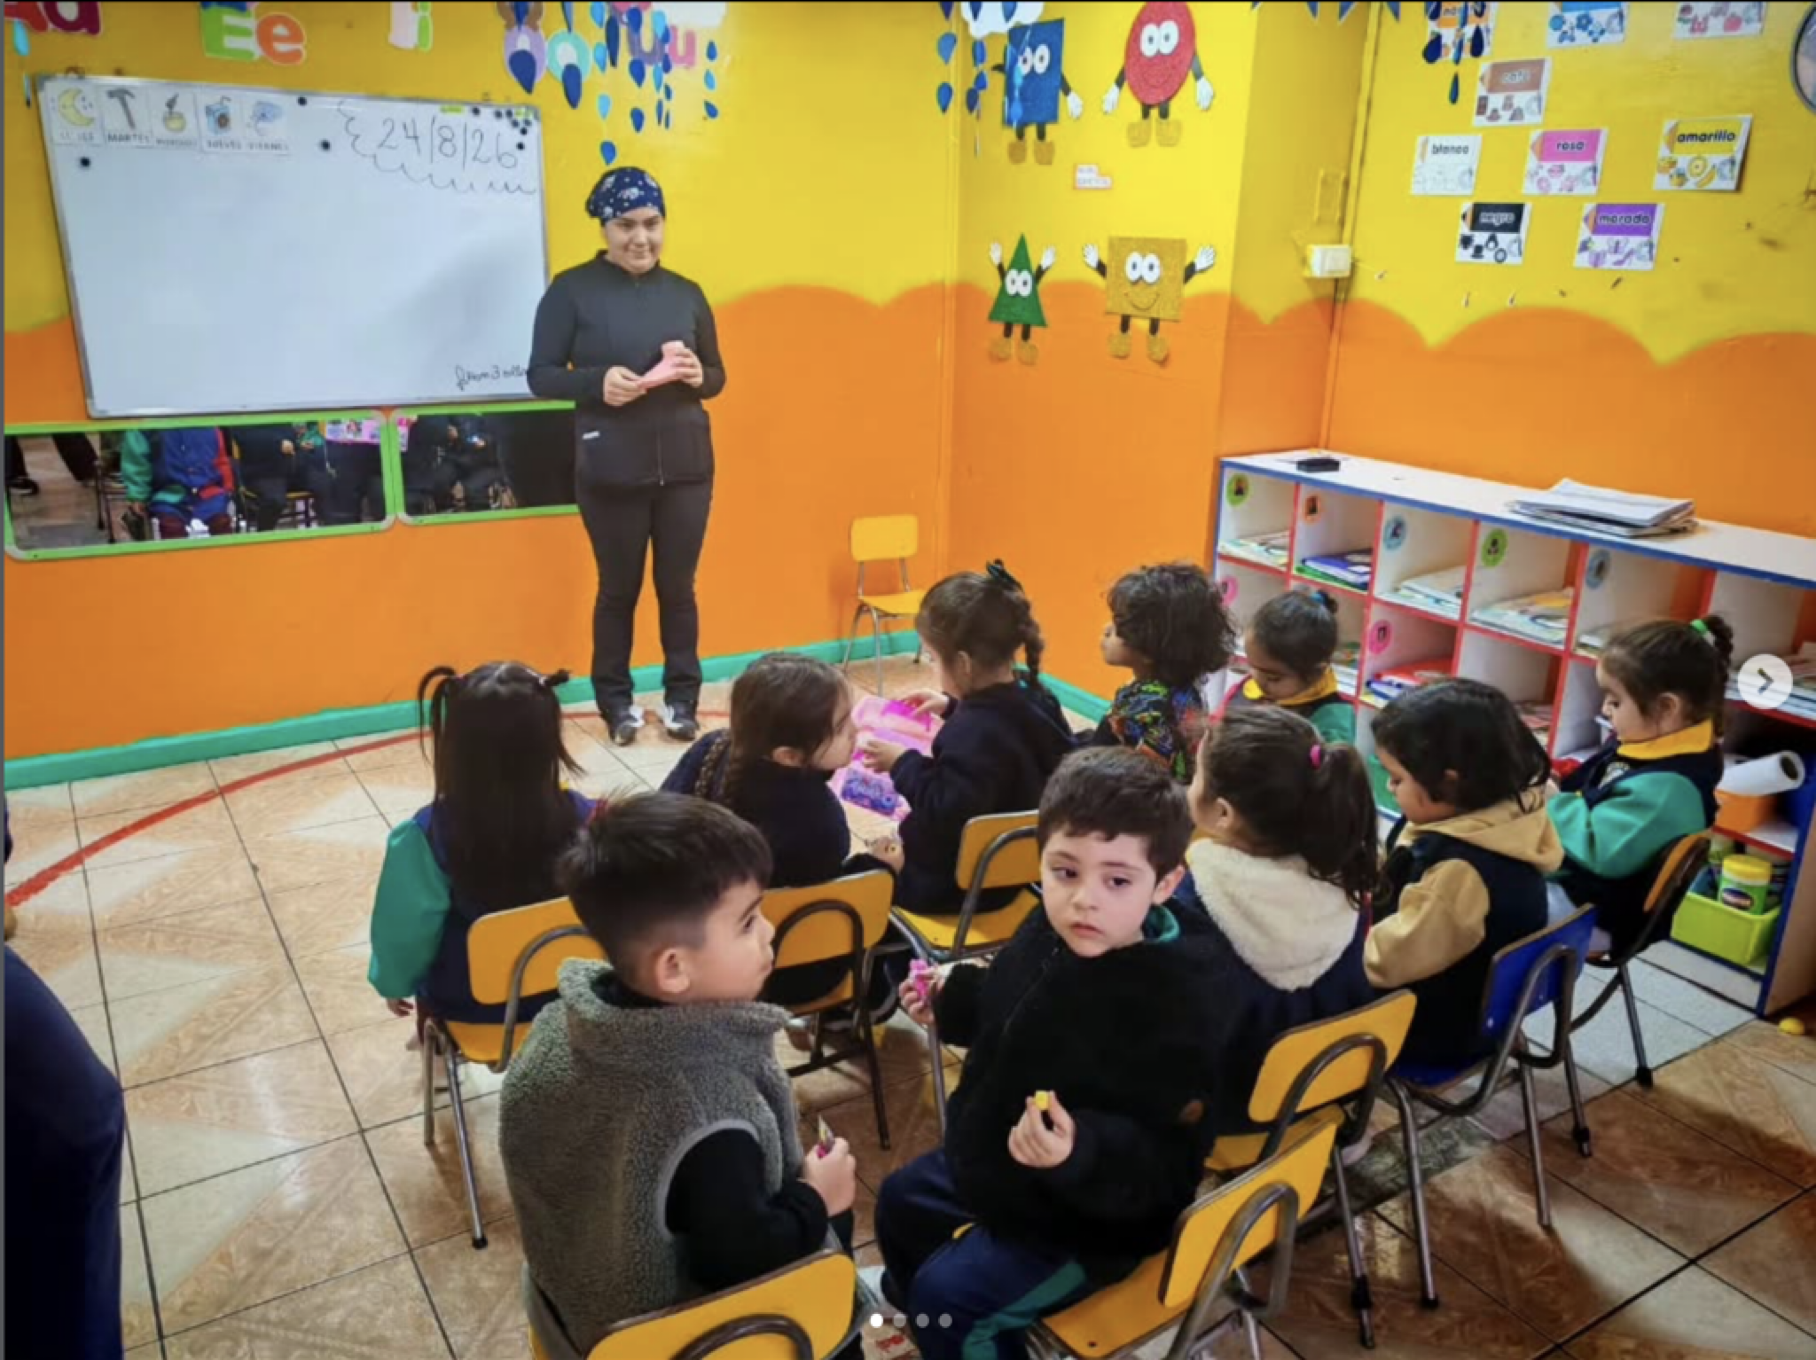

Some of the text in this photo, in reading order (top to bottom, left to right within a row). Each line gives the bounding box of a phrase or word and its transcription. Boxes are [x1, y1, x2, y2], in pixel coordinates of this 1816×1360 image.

[201, 8, 304, 65] Ee
[377, 115, 518, 170] 24/8/26
[1677, 129, 1735, 143] amarillo
[1431, 143, 1469, 155] blanco
[1556, 141, 1585, 151] rosa
[1479, 212, 1515, 227] negro
[1600, 213, 1650, 225] morado
